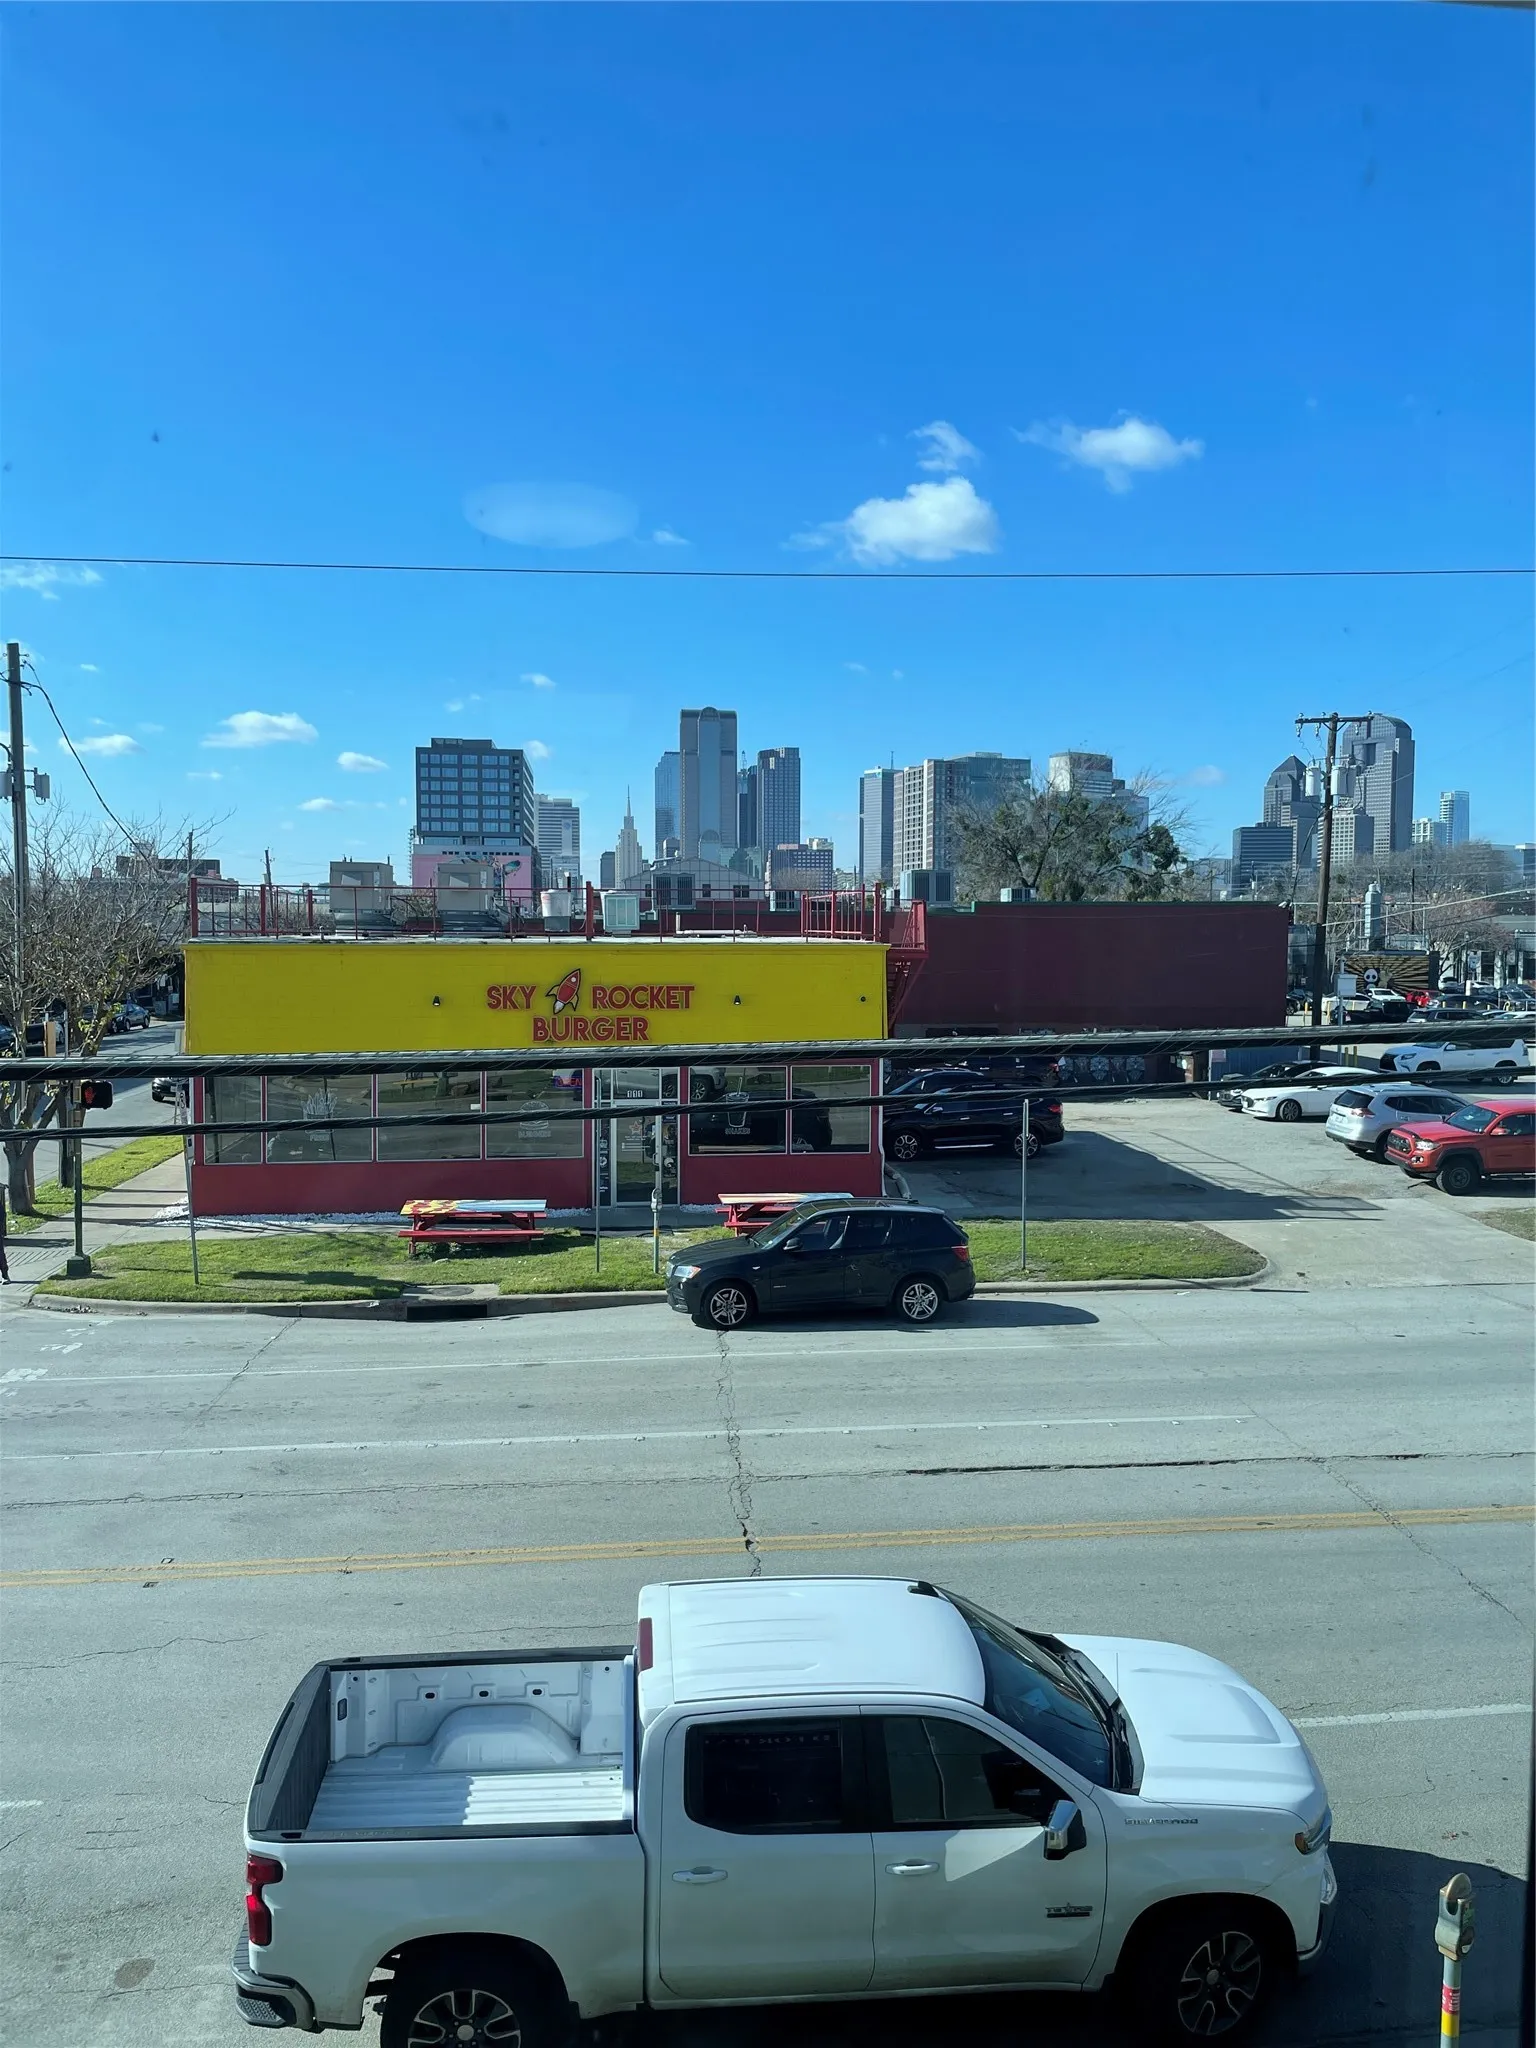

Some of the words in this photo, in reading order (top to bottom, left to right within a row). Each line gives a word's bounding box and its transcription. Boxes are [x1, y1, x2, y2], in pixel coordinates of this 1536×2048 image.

[487, 984, 537, 1010] SKY
[591, 984, 695, 1010] ROCKET
[532, 1015, 650, 1042] BURGER
